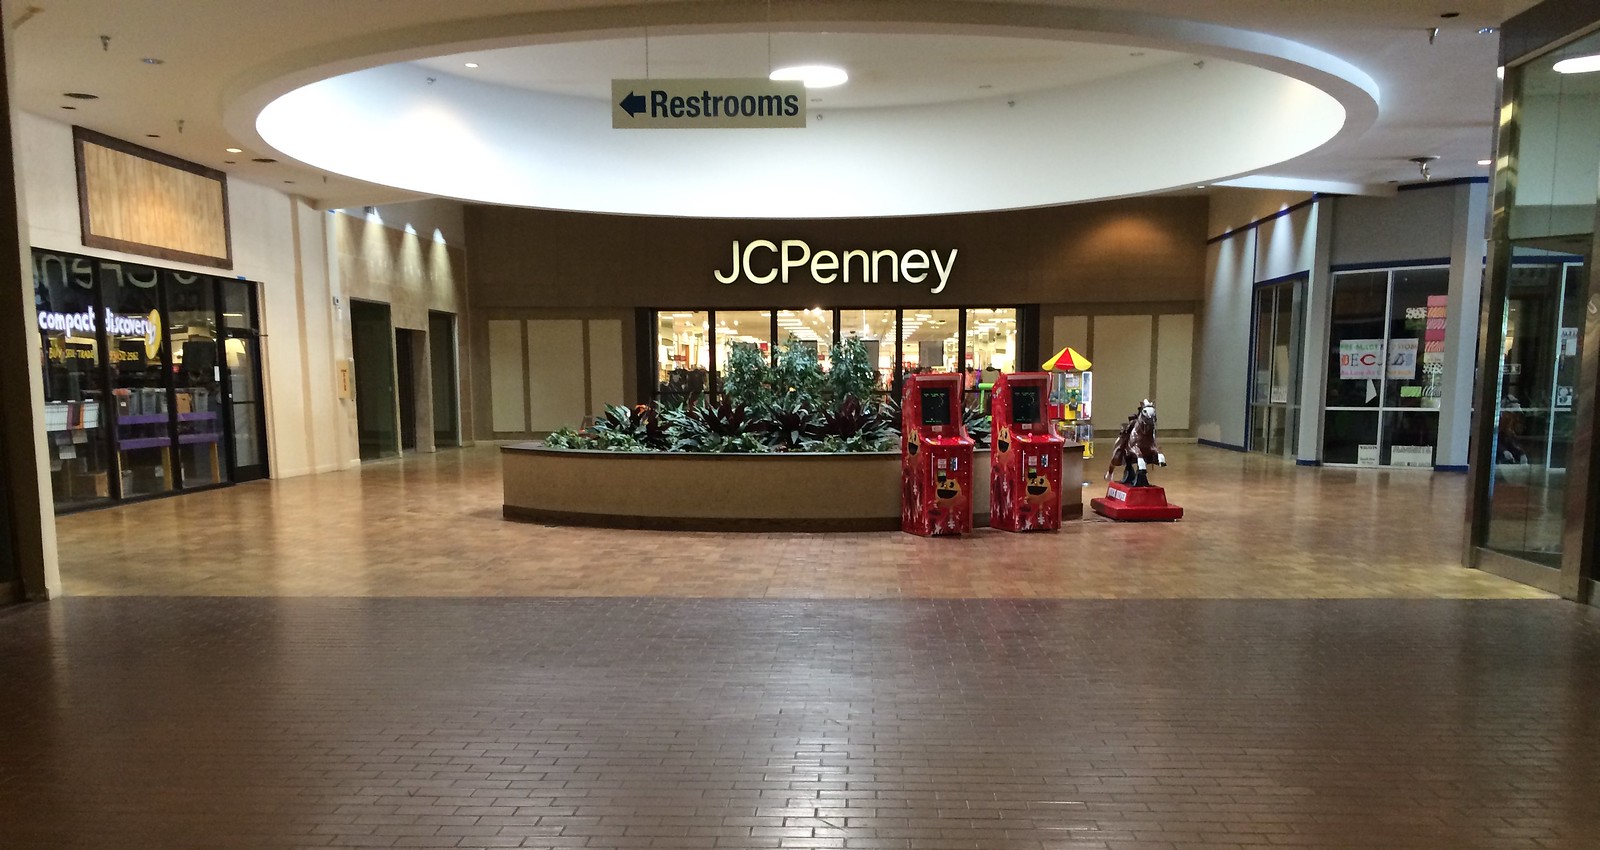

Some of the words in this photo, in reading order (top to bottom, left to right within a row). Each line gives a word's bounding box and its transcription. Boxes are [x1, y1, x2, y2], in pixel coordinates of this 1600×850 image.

[650, 90, 799, 118] Restrooms
[713, 239, 959, 294] JCPenney
[38, 305, 96, 338] compact
